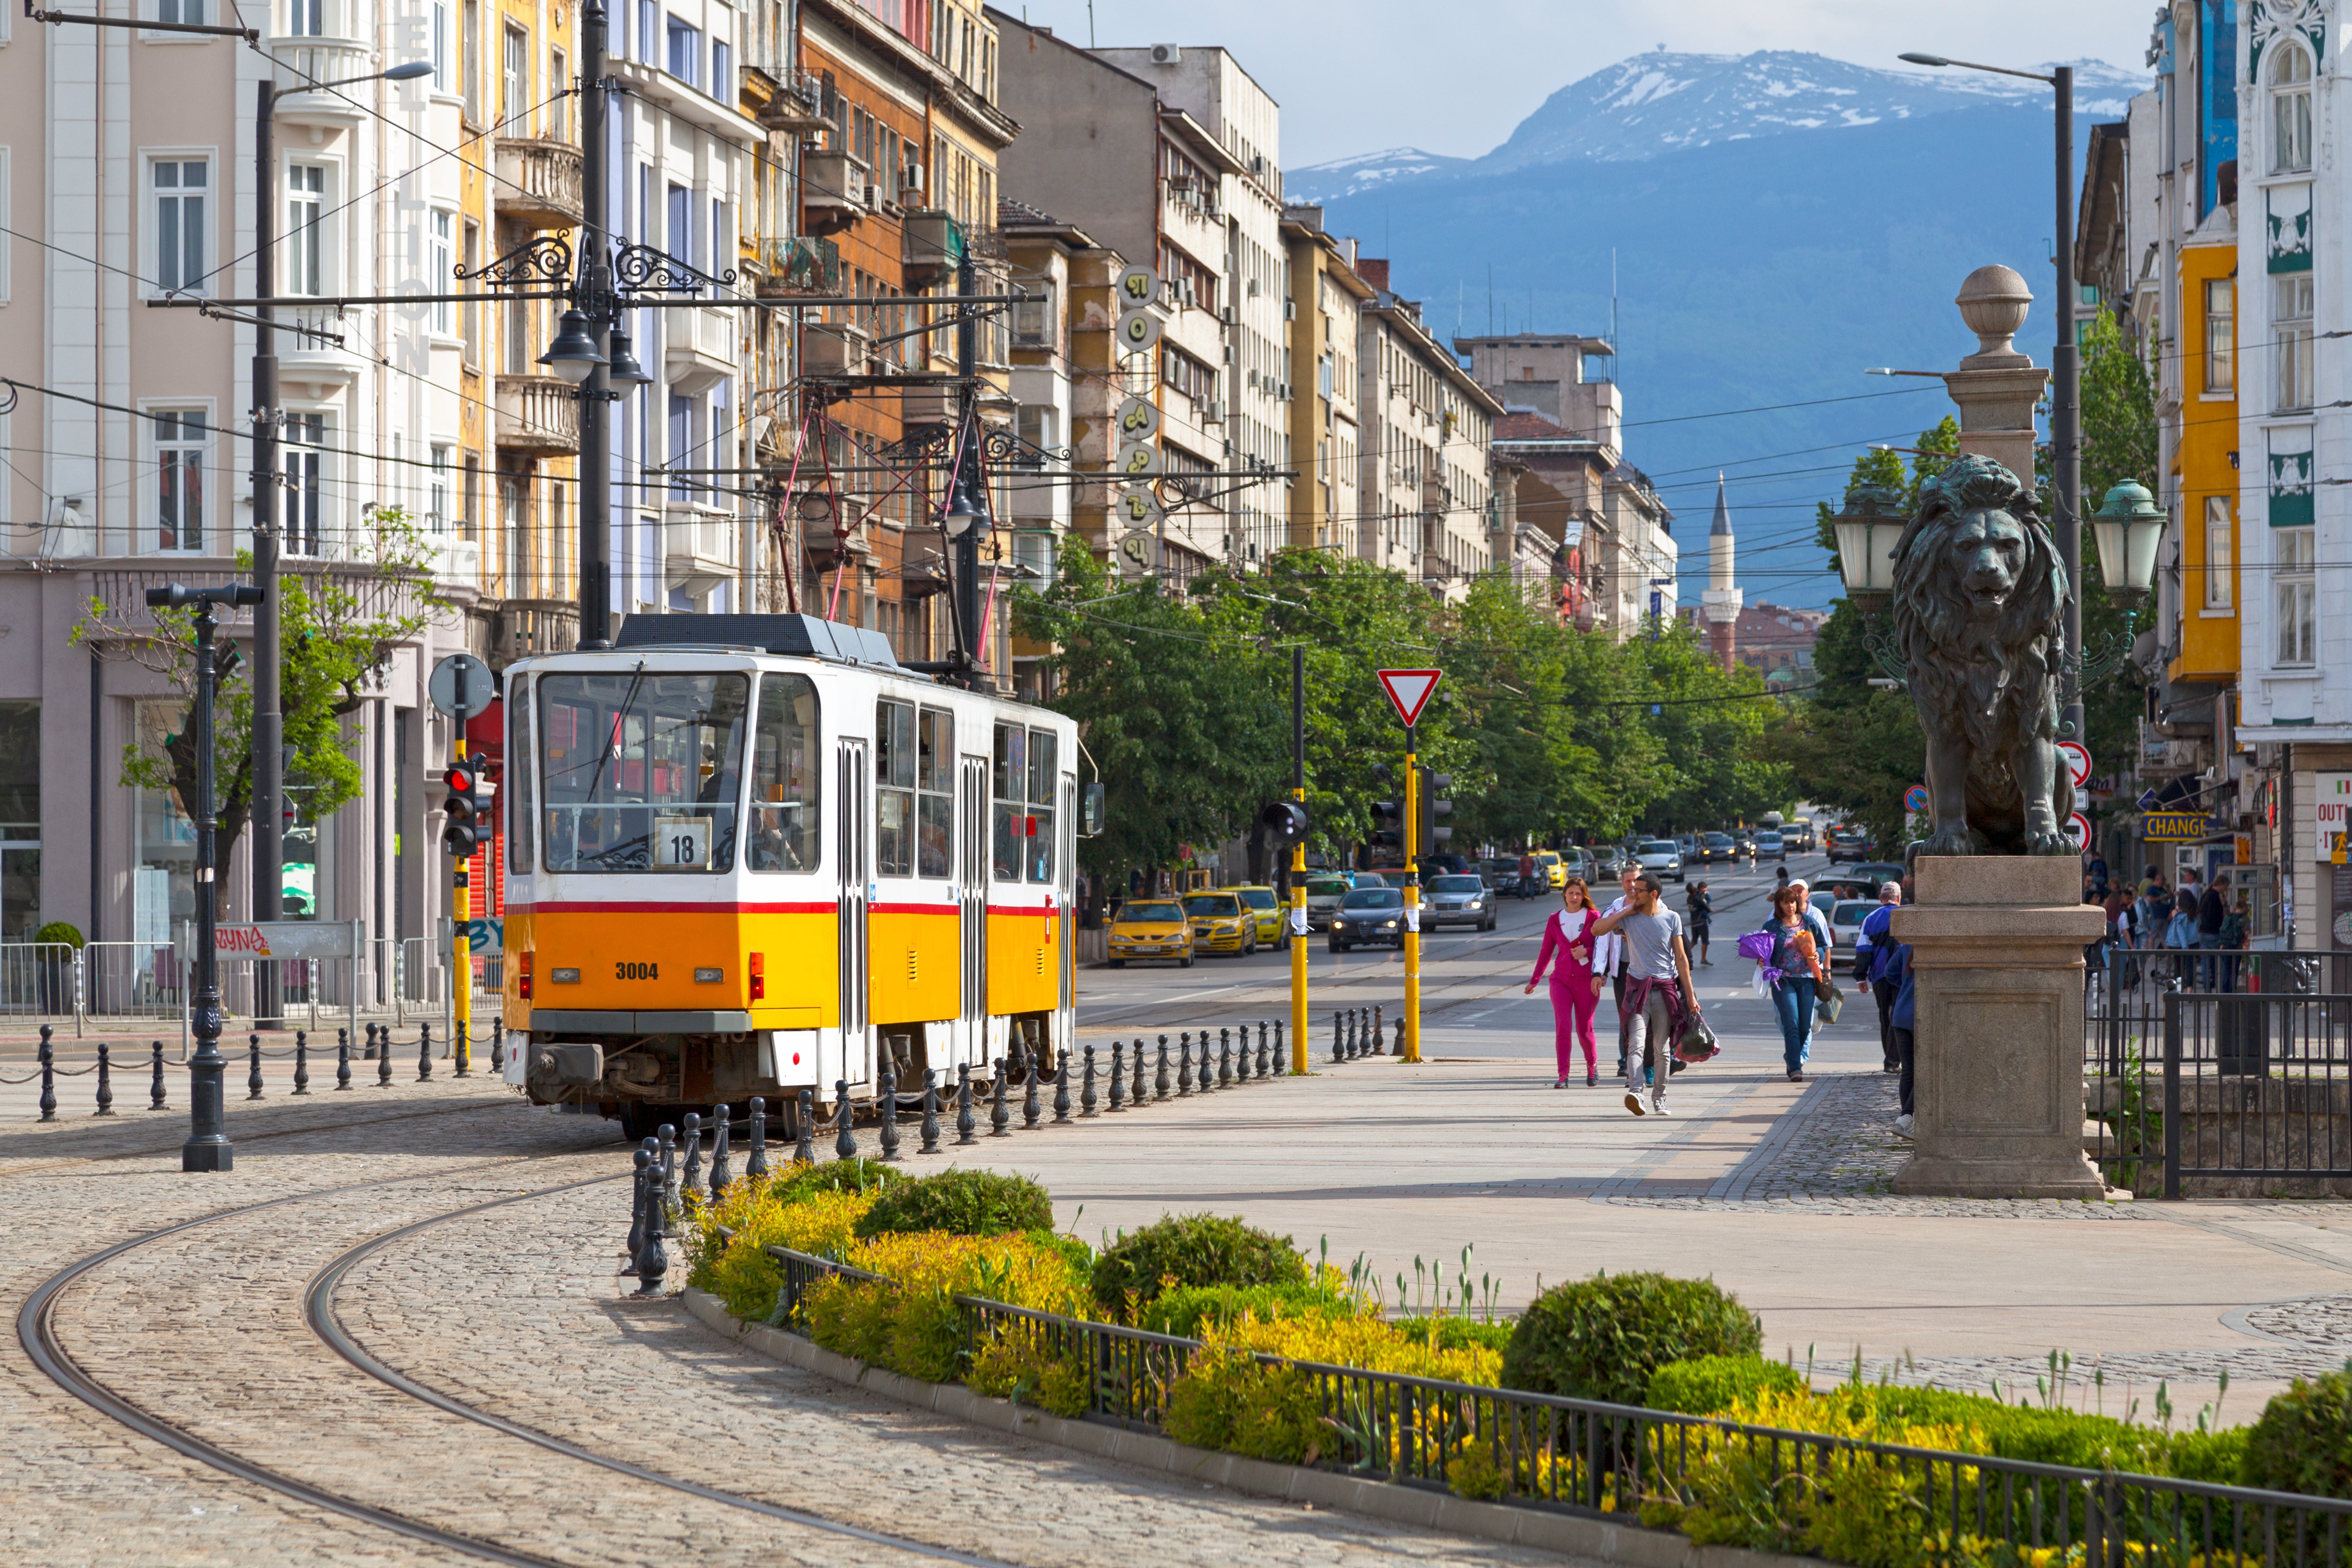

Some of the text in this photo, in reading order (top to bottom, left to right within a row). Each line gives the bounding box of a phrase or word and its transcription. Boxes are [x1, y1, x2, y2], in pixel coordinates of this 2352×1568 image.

[396, 0, 431, 376] EL LION
[2147, 818, 2208, 836] CHANGE
[671, 835, 694, 863] 18
[616, 962, 659, 980] 3004
